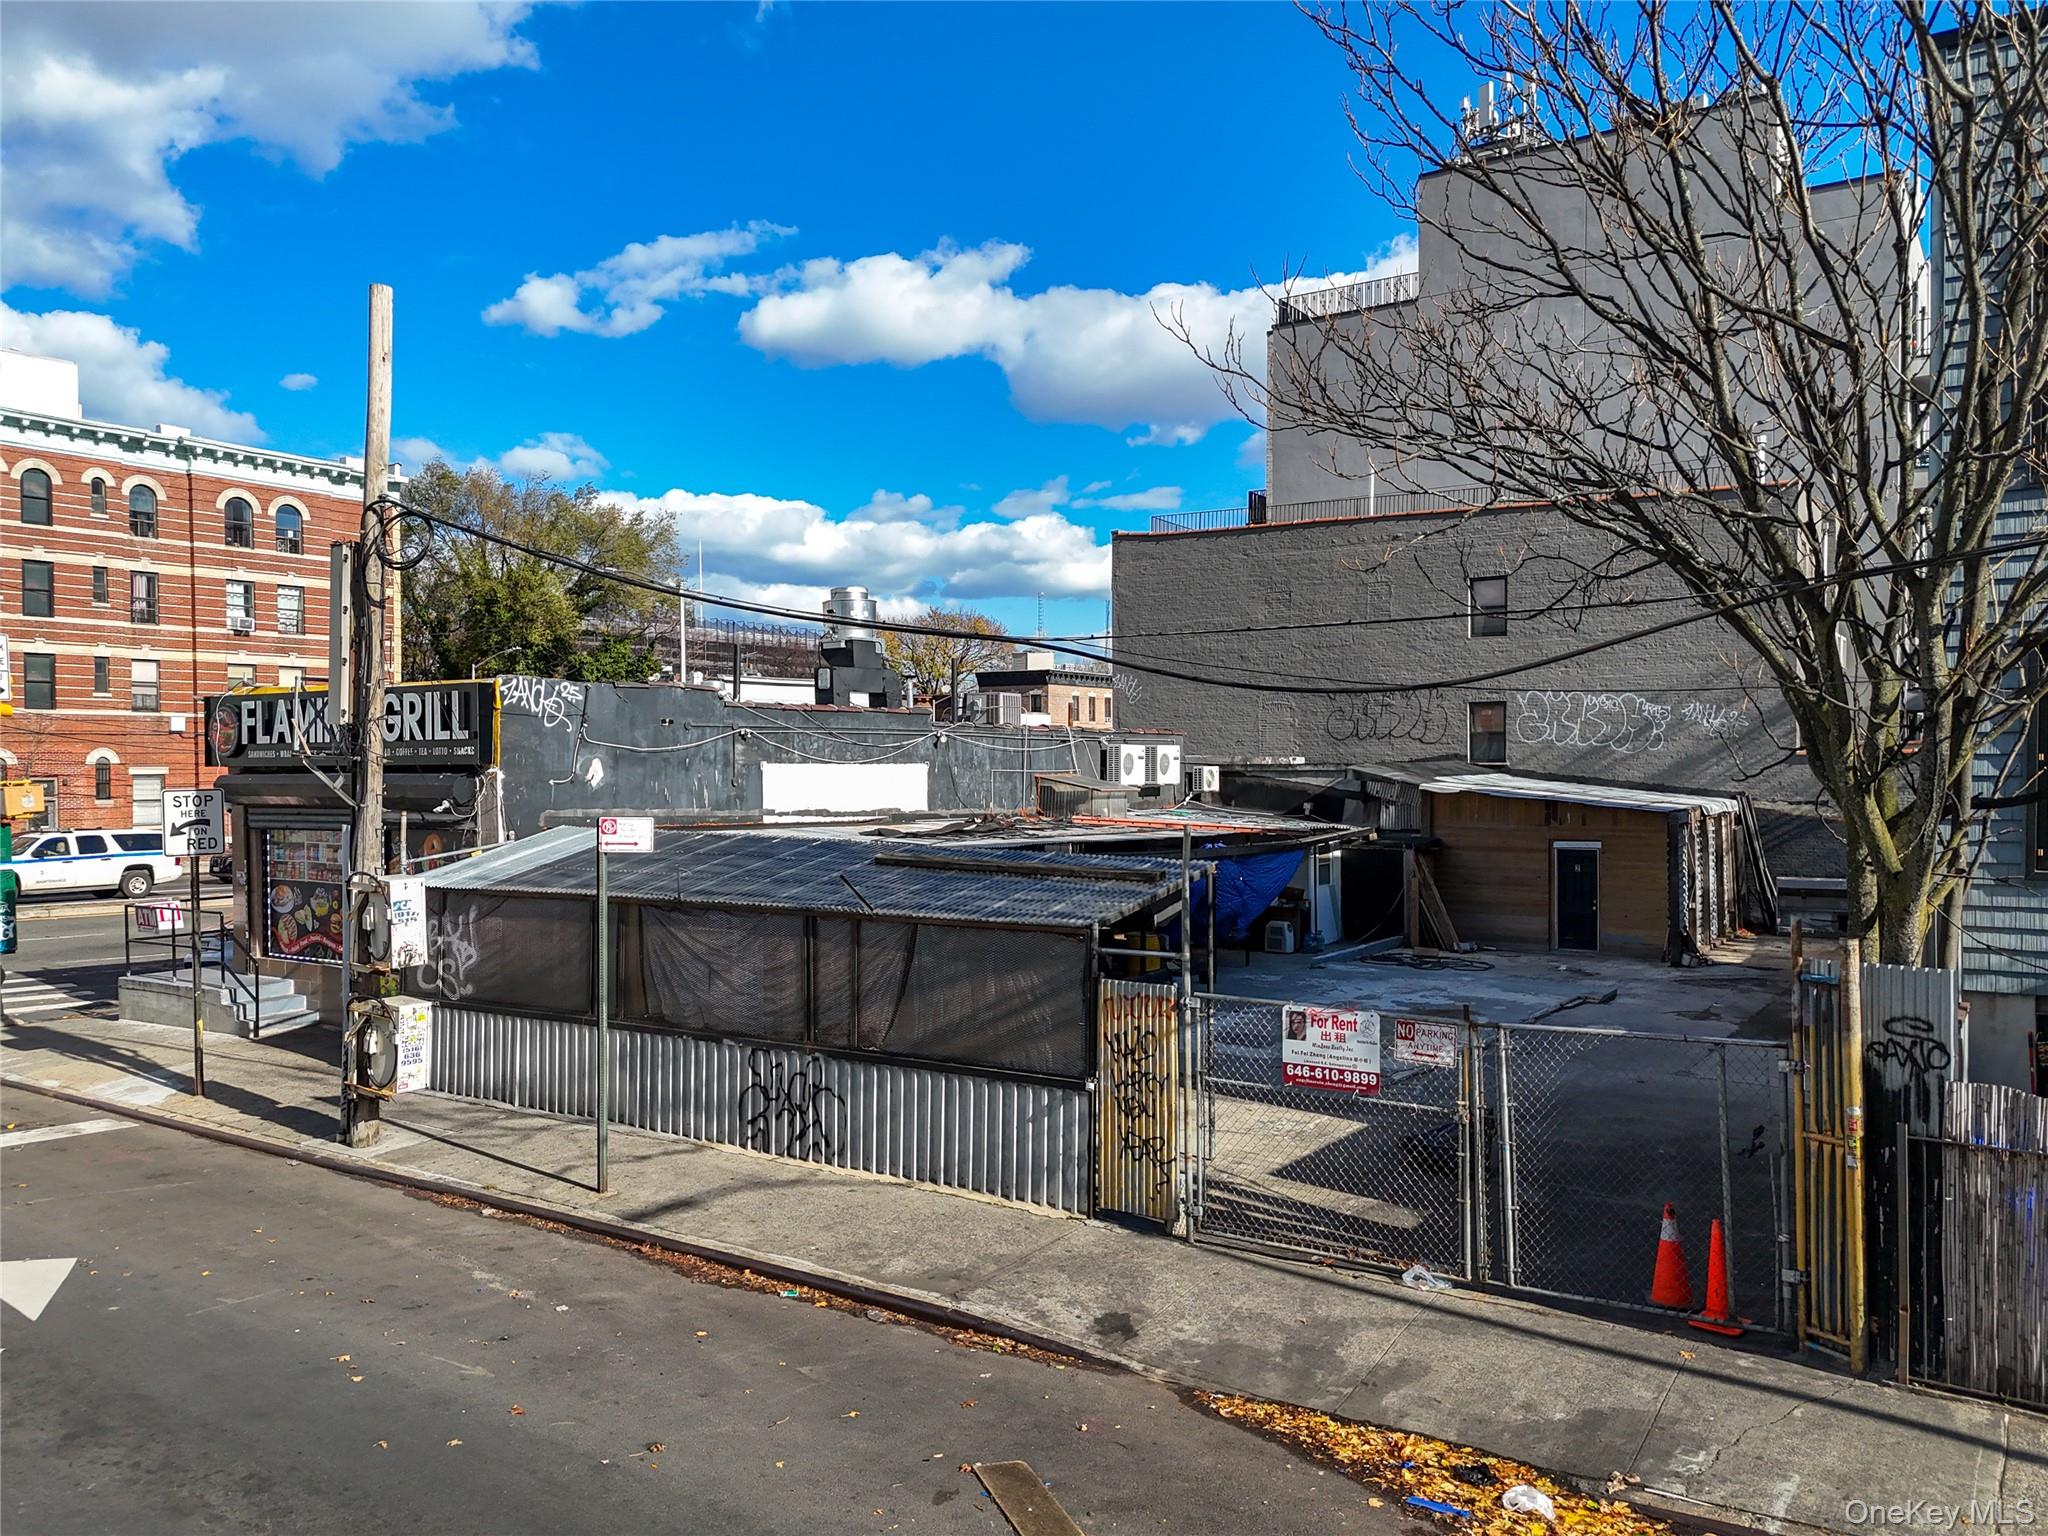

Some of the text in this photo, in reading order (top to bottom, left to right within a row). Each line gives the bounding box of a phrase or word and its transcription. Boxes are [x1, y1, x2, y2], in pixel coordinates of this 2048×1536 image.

[383, 689, 469, 742] GRILL
[247, 750, 276, 759] SANDWICHES
[418, 747, 428, 756] TEA
[432, 747, 448, 756] LOTTO
[453, 746, 475, 755] SNACKS
[172, 795, 214, 808] STOP
[180, 810, 207, 818] HERE
[193, 827, 208, 836] ON
[187, 837, 218, 850] RED
[1310, 1014, 1358, 1032] For Rent
[1397, 1023, 1454, 1041] NO PARKING
[1407, 1042, 1443, 1052] ANYTIME
[1286, 1064, 1377, 1086] 646-610-9899
